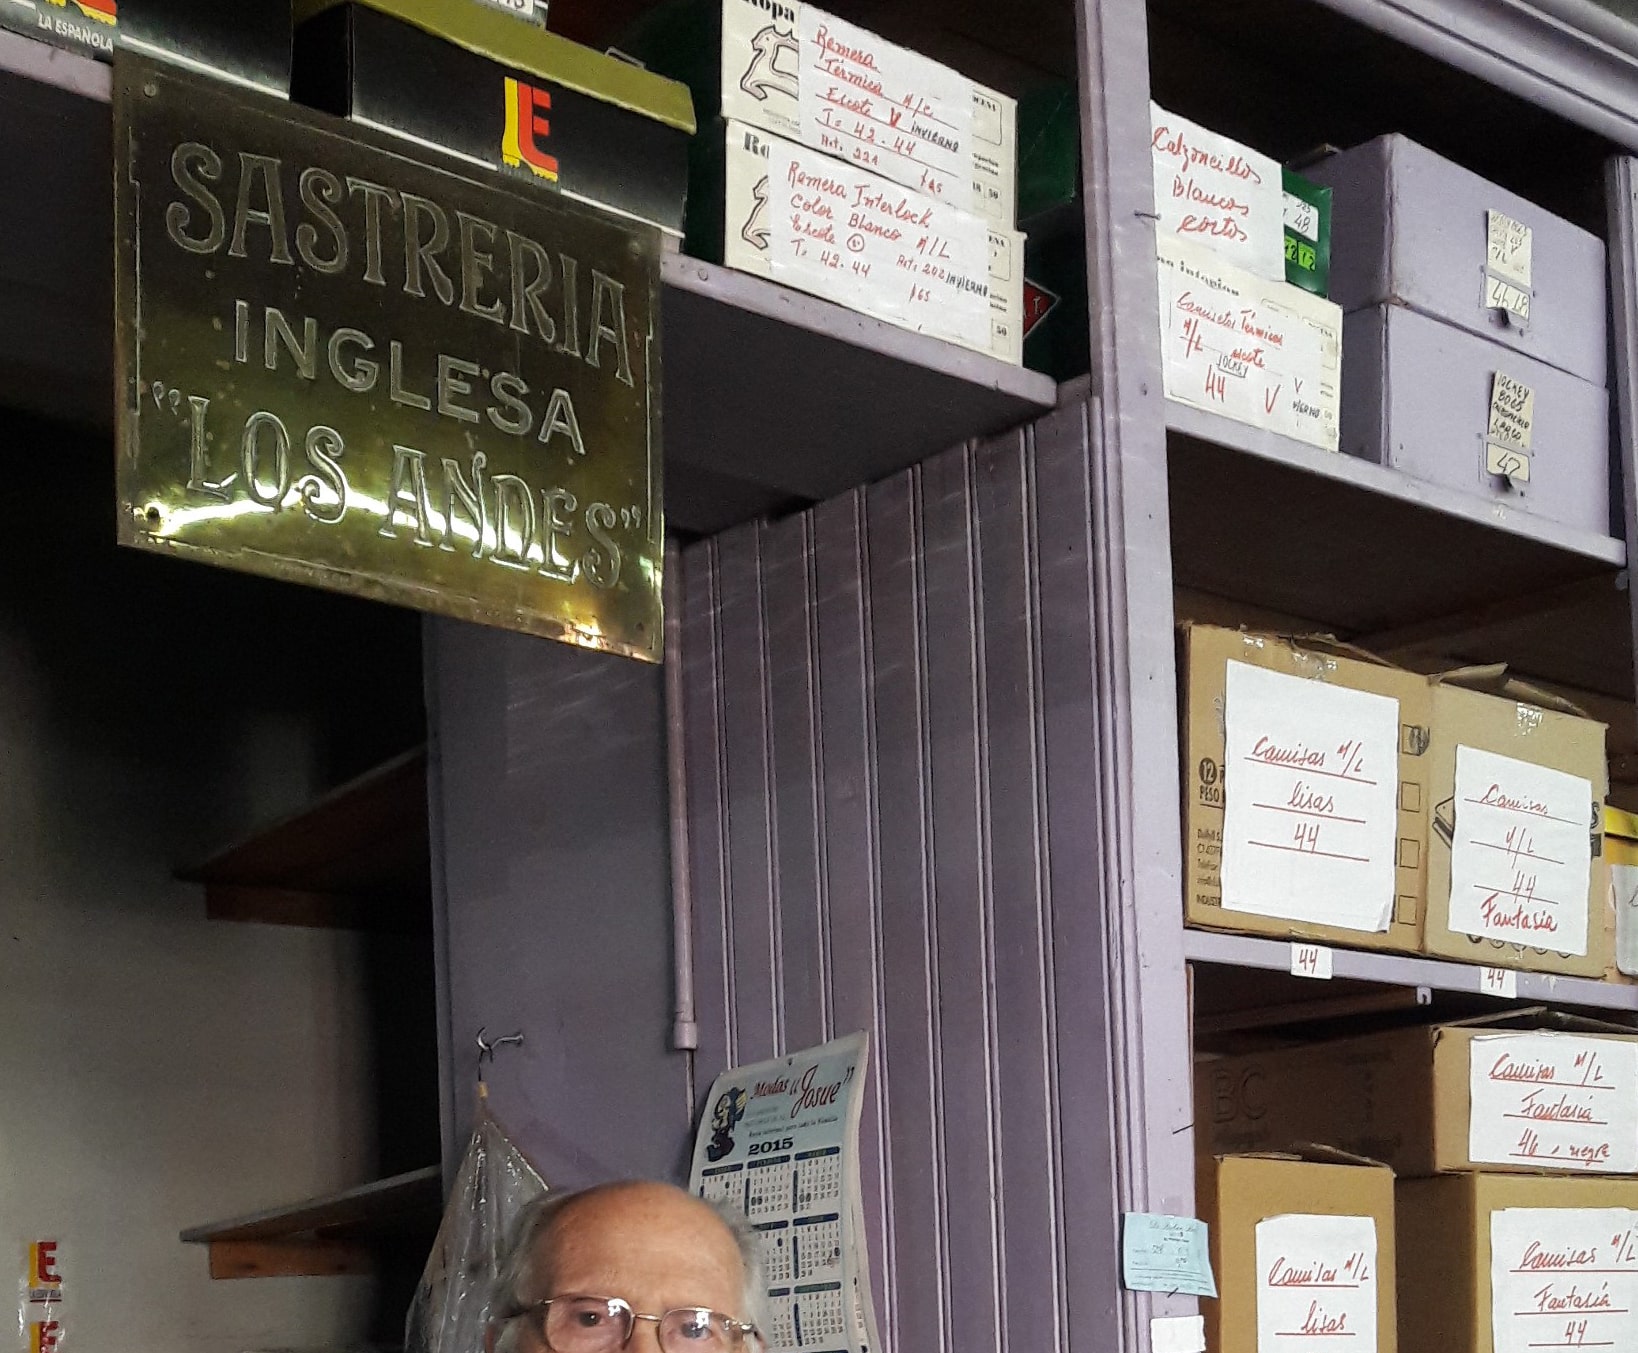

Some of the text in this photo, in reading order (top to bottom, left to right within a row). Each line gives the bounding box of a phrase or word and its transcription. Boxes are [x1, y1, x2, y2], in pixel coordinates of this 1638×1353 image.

[38, 13, 53, 31] LA
[889, 106, 902, 128] V
[893, 136, 916, 156] 44
[788, 160, 847, 200] Remera
[847, 213, 903, 241] Blanco
[166, 141, 635, 389] SASTRERIA
[851, 260, 872, 279] 44
[234, 300, 587, 456] INGLESA
[1204, 363, 1227, 404] 44
[1265, 383, 1282, 415] V
[1293, 823, 1320, 854] 44
[1512, 874, 1537, 903] 44
[1298, 947, 1319, 969] 44
[1487, 967, 1505, 989] 44
[748, 1137, 794, 1157] 2015
[1564, 1320, 1588, 1348] 44
